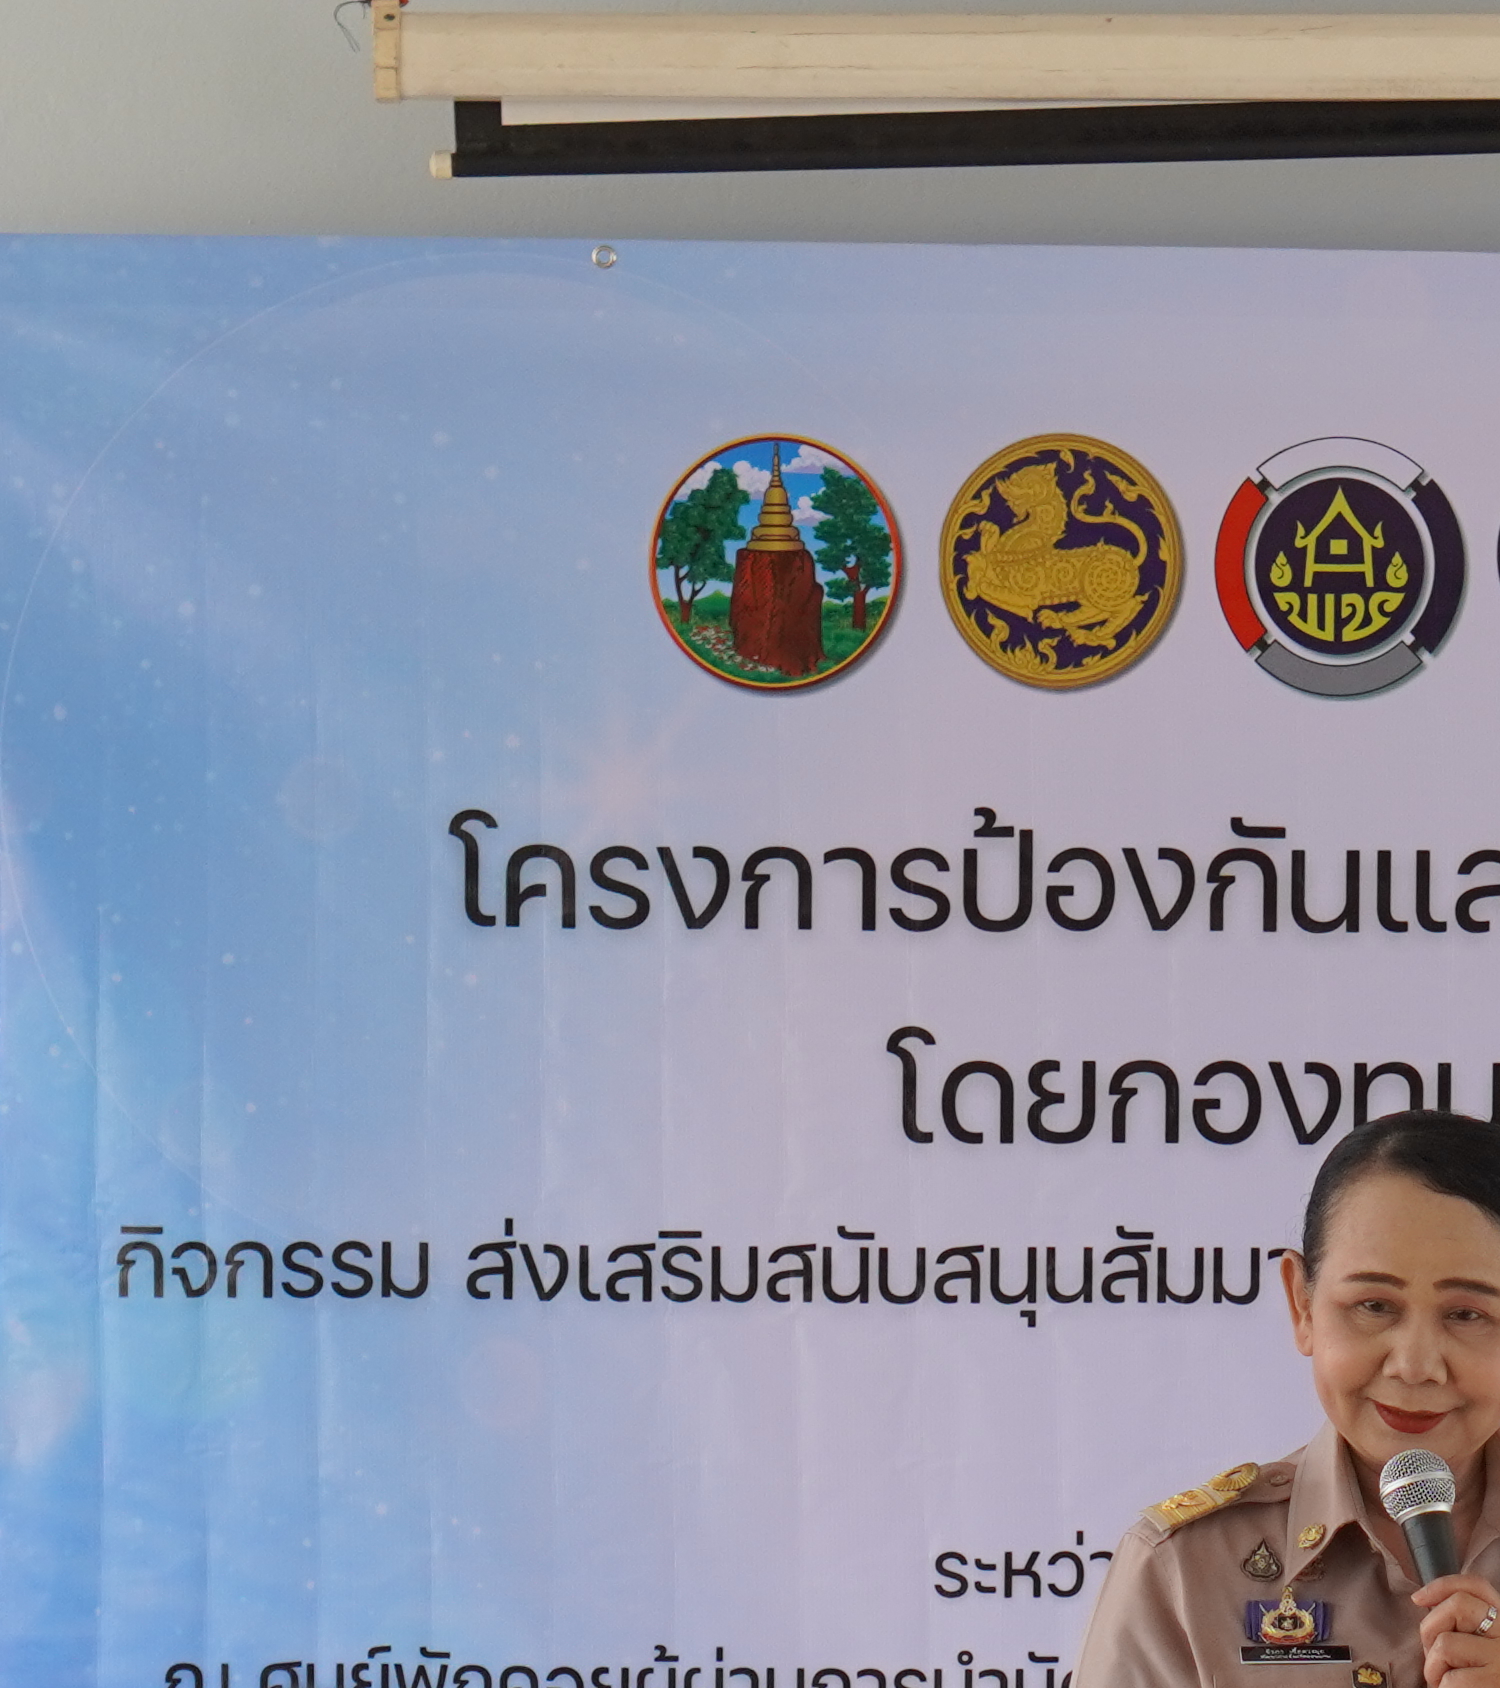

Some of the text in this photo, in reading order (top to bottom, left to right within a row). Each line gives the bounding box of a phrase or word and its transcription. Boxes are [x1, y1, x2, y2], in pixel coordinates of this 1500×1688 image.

[117, 1226, 429, 1298] กิจกรรม
[934, 1530, 1114, 1598] ระหว่
